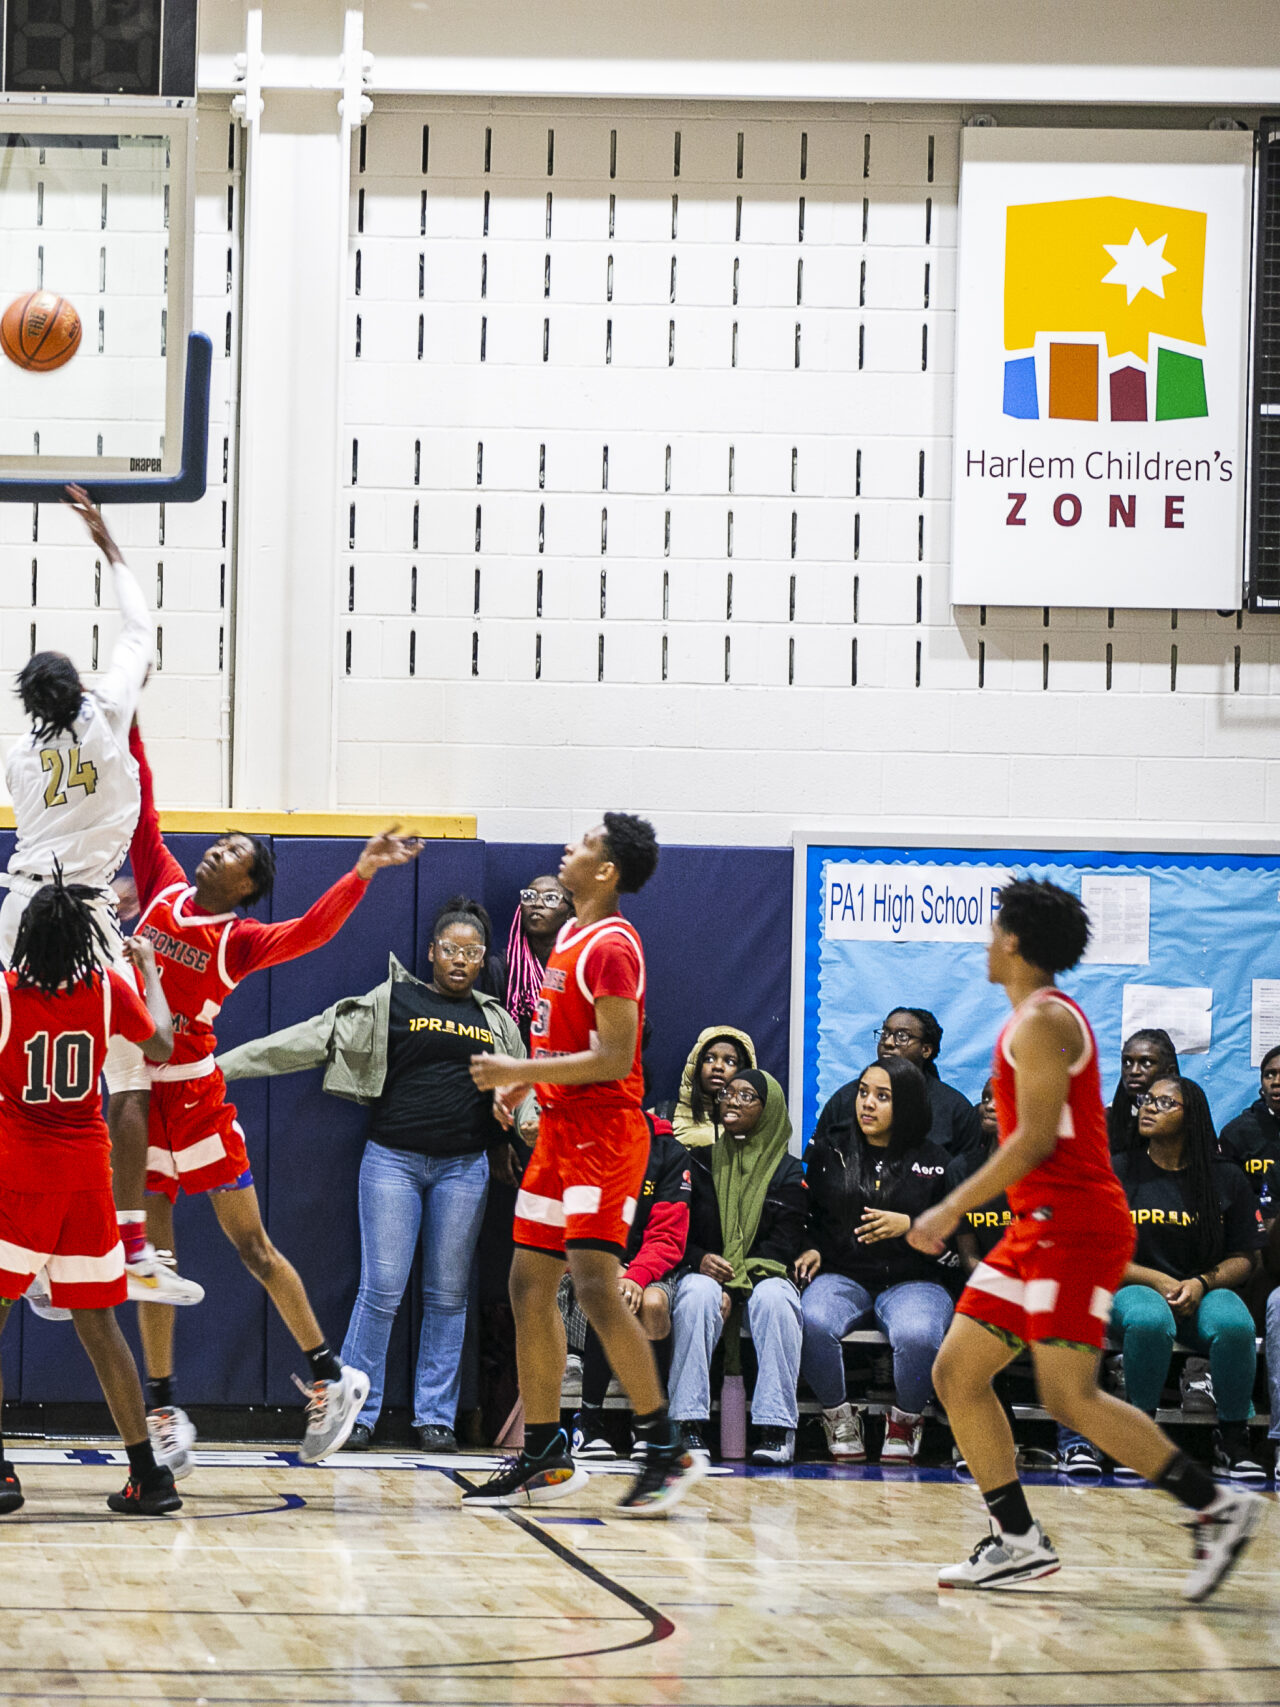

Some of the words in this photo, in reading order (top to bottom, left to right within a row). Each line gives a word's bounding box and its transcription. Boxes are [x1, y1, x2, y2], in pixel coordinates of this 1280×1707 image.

[130, 458, 161, 472] DRAPER
[966, 449, 1075, 480] Harlem
[1085, 450, 1234, 482] Children's
[1006, 493, 1186, 529] ZONE
[40, 747, 98, 808] 24
[830, 882, 864, 922] PA1
[873, 883, 915, 933] High
[921, 884, 983, 925] School
[22, 1030, 95, 1104] 10
[911, 1161, 945, 1175] Aero
